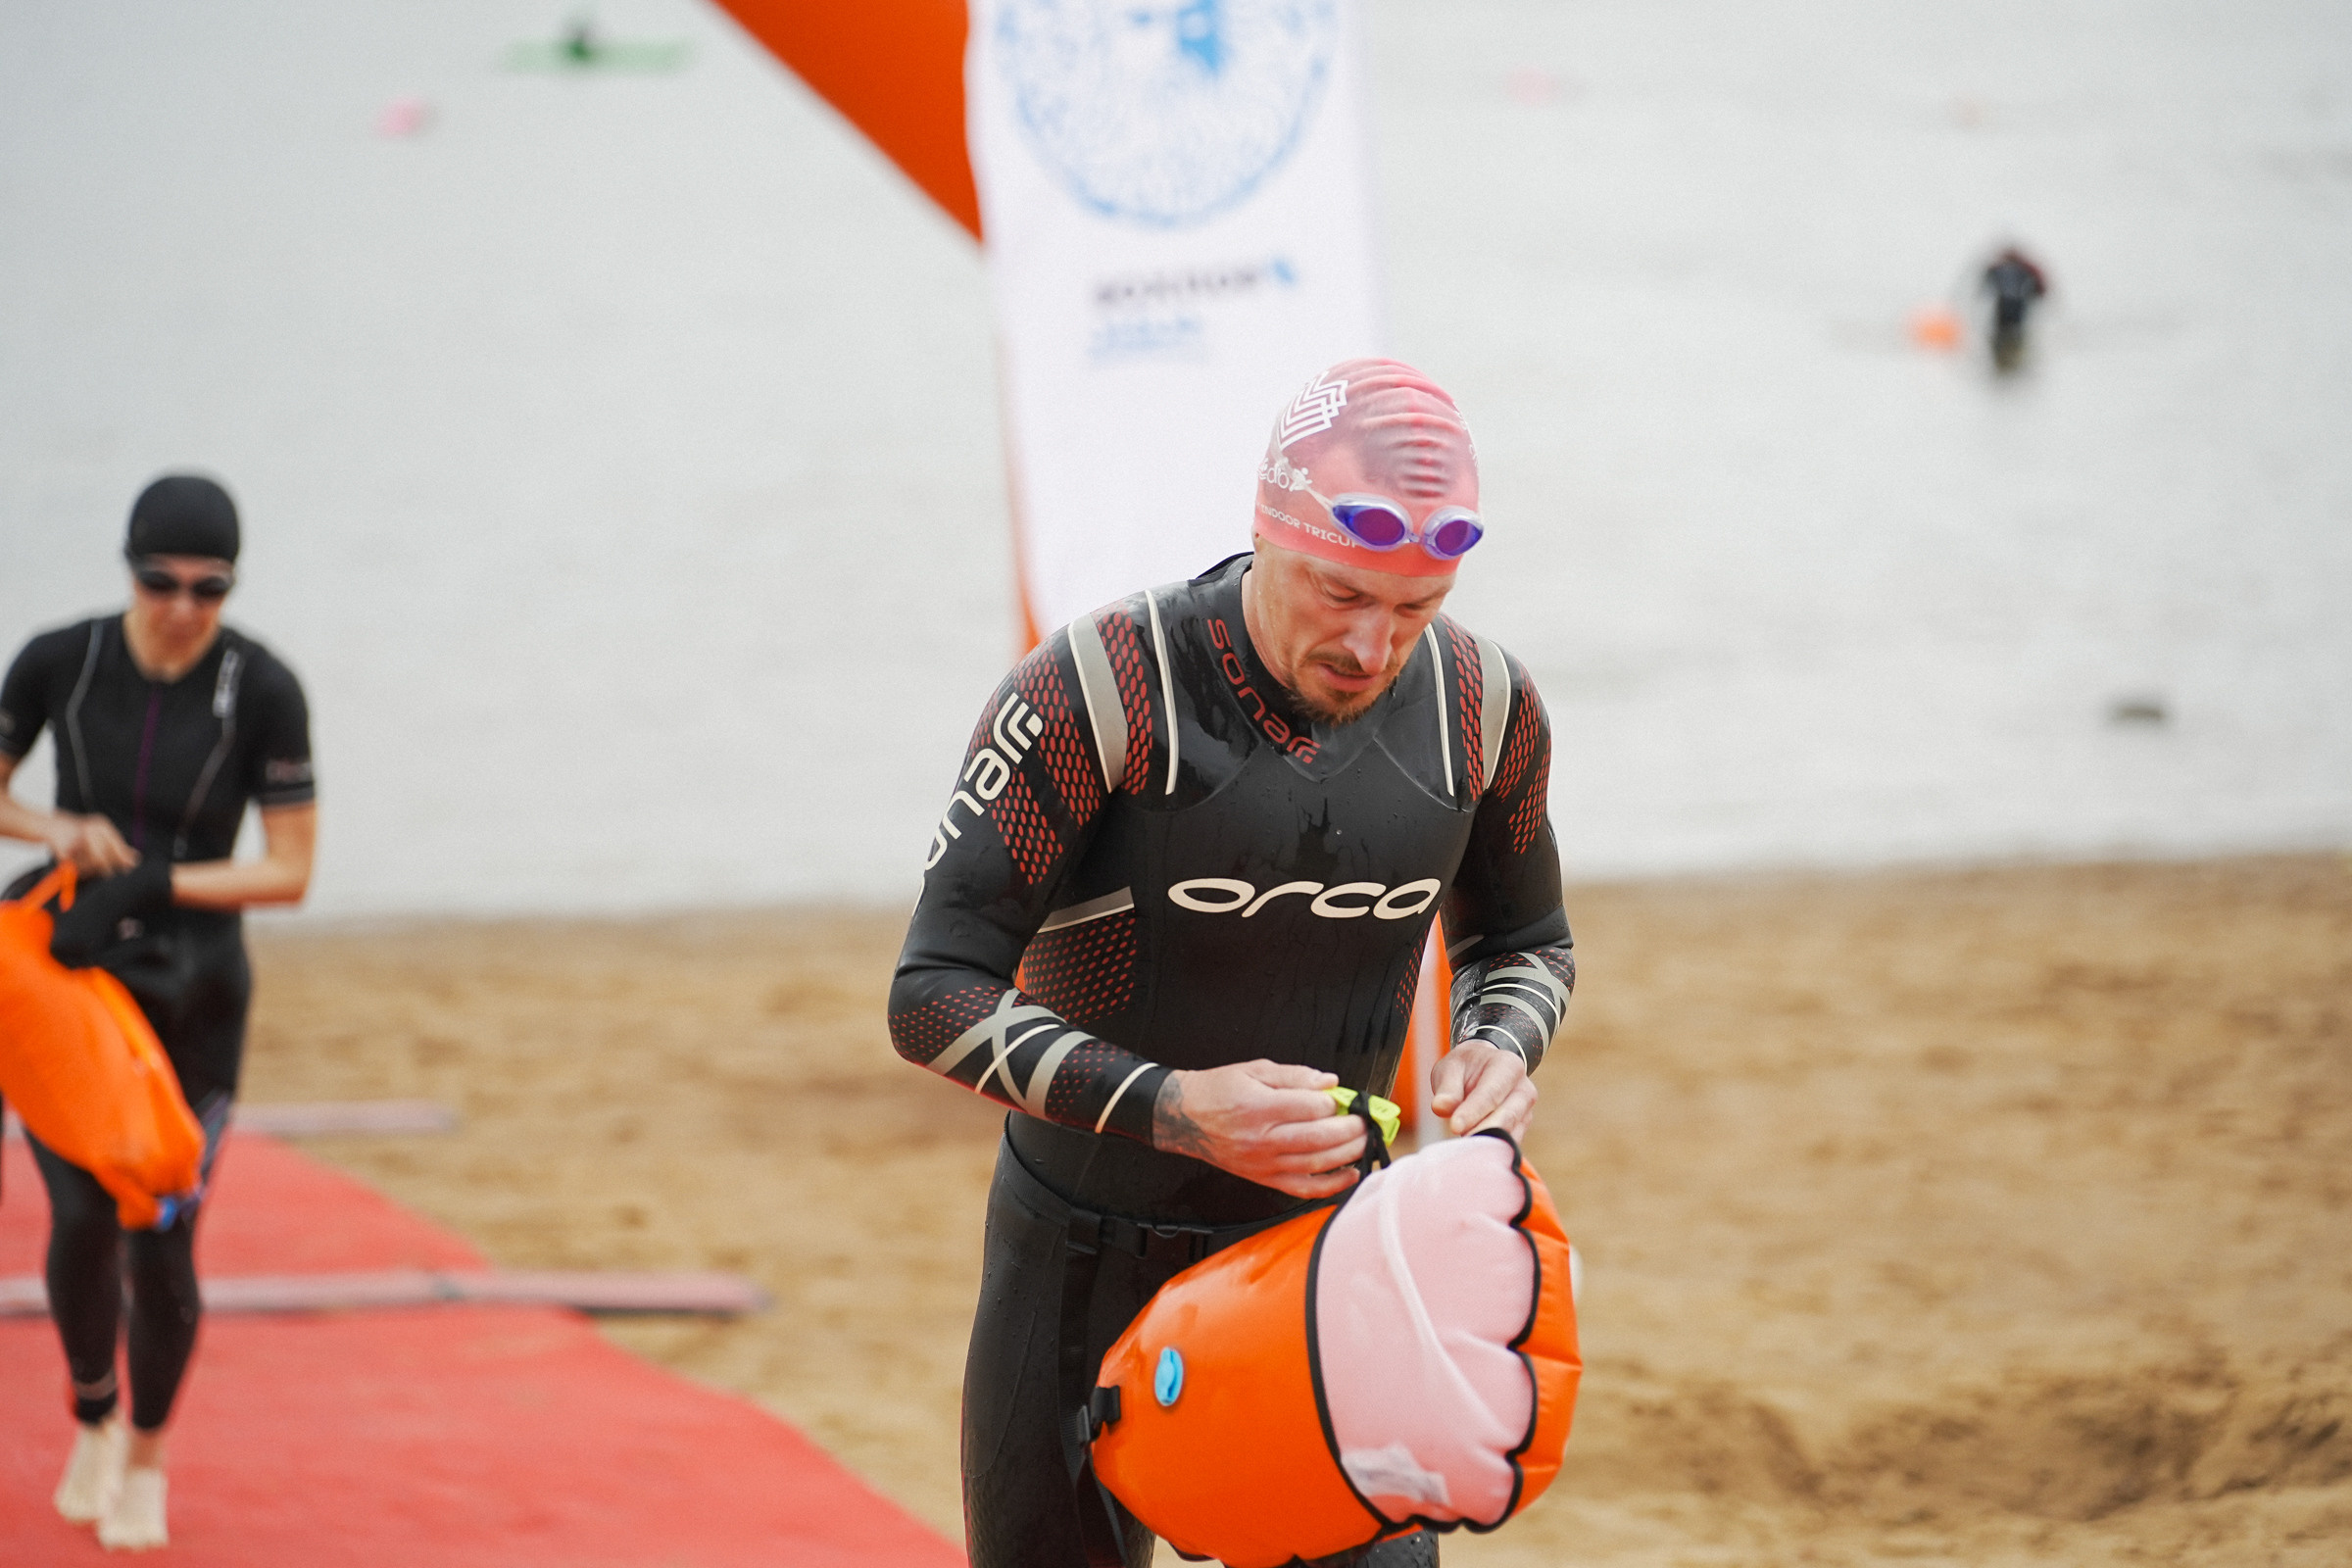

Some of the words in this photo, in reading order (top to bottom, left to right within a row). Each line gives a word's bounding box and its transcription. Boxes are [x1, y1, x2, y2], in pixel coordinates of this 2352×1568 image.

[1260, 504, 1300, 529] INDOOR
[1206, 618, 1322, 764] sonar
[911, 692, 1044, 917] onar
[1167, 877, 1442, 920] orca
